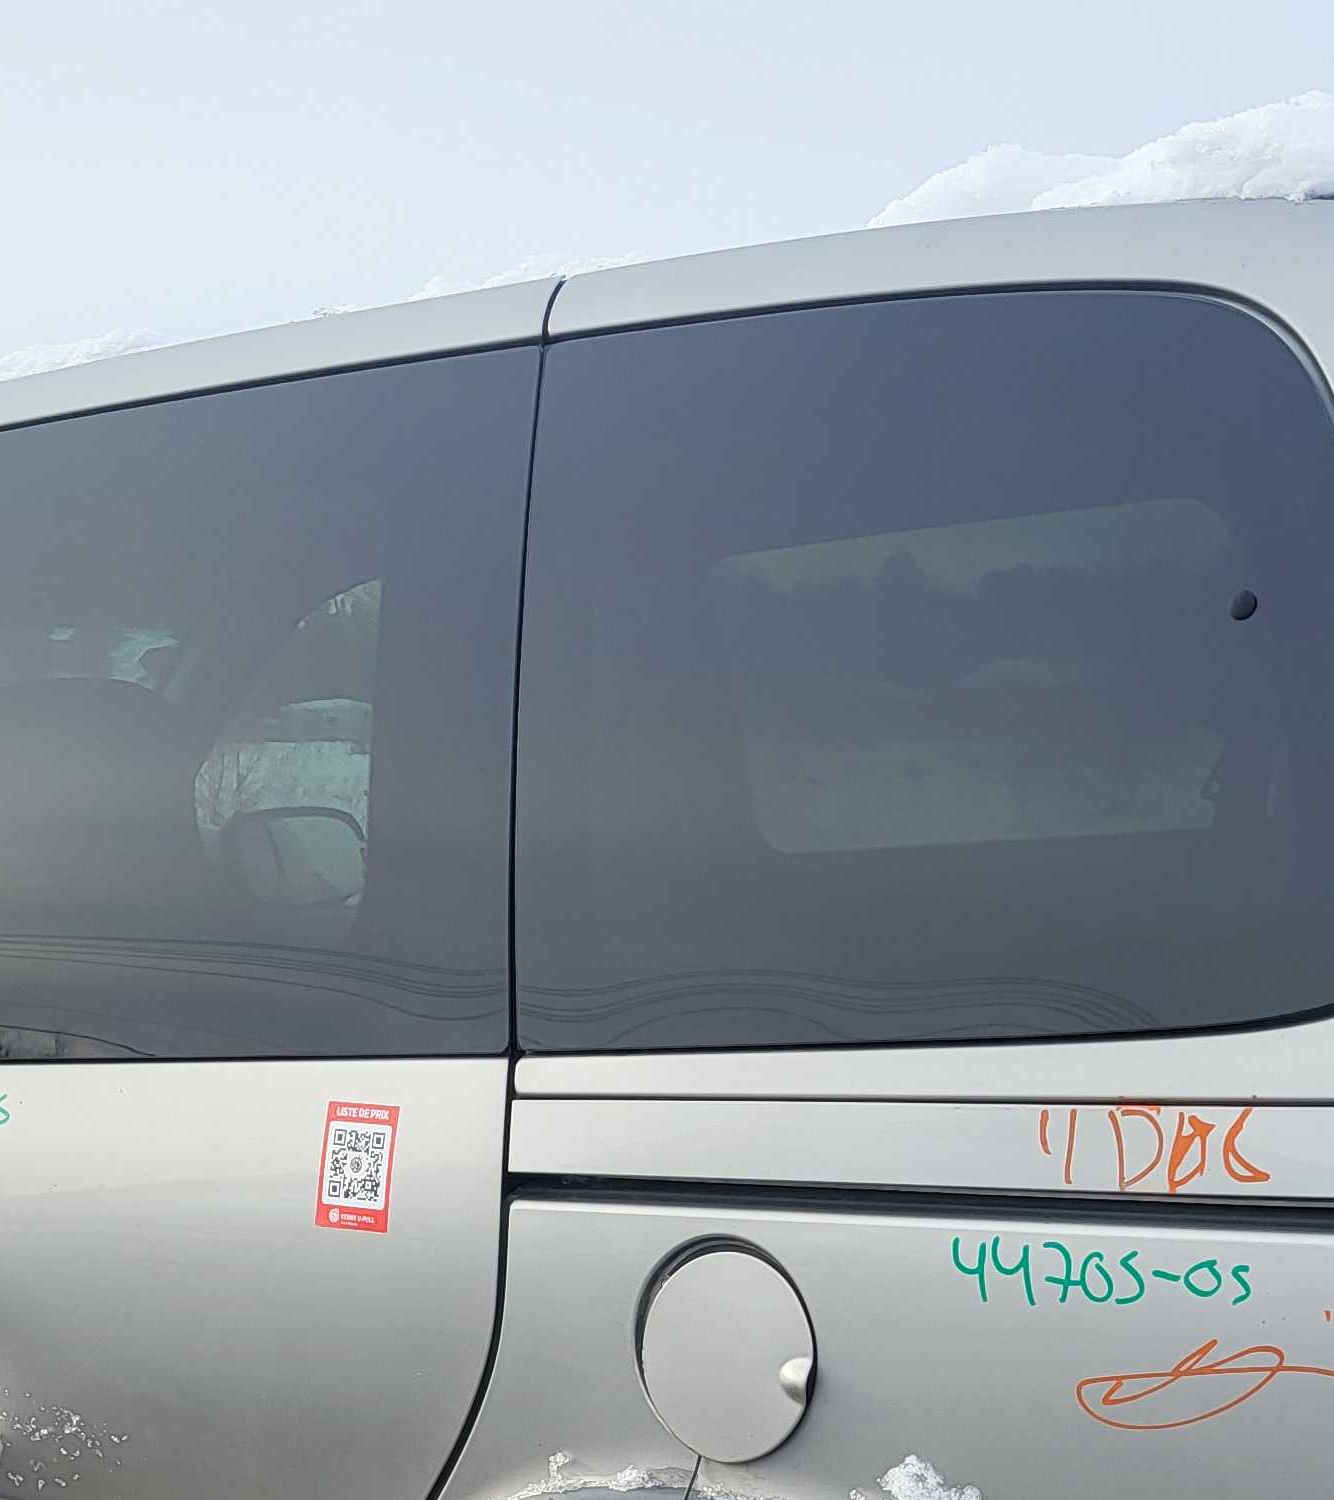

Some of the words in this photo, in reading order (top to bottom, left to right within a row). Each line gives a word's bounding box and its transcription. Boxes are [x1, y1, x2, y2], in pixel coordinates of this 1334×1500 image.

[336, 1106, 358, 1118] LISTE
[359, 1108, 370, 1119] DE
[370, 1109, 390, 1121] PRIX
